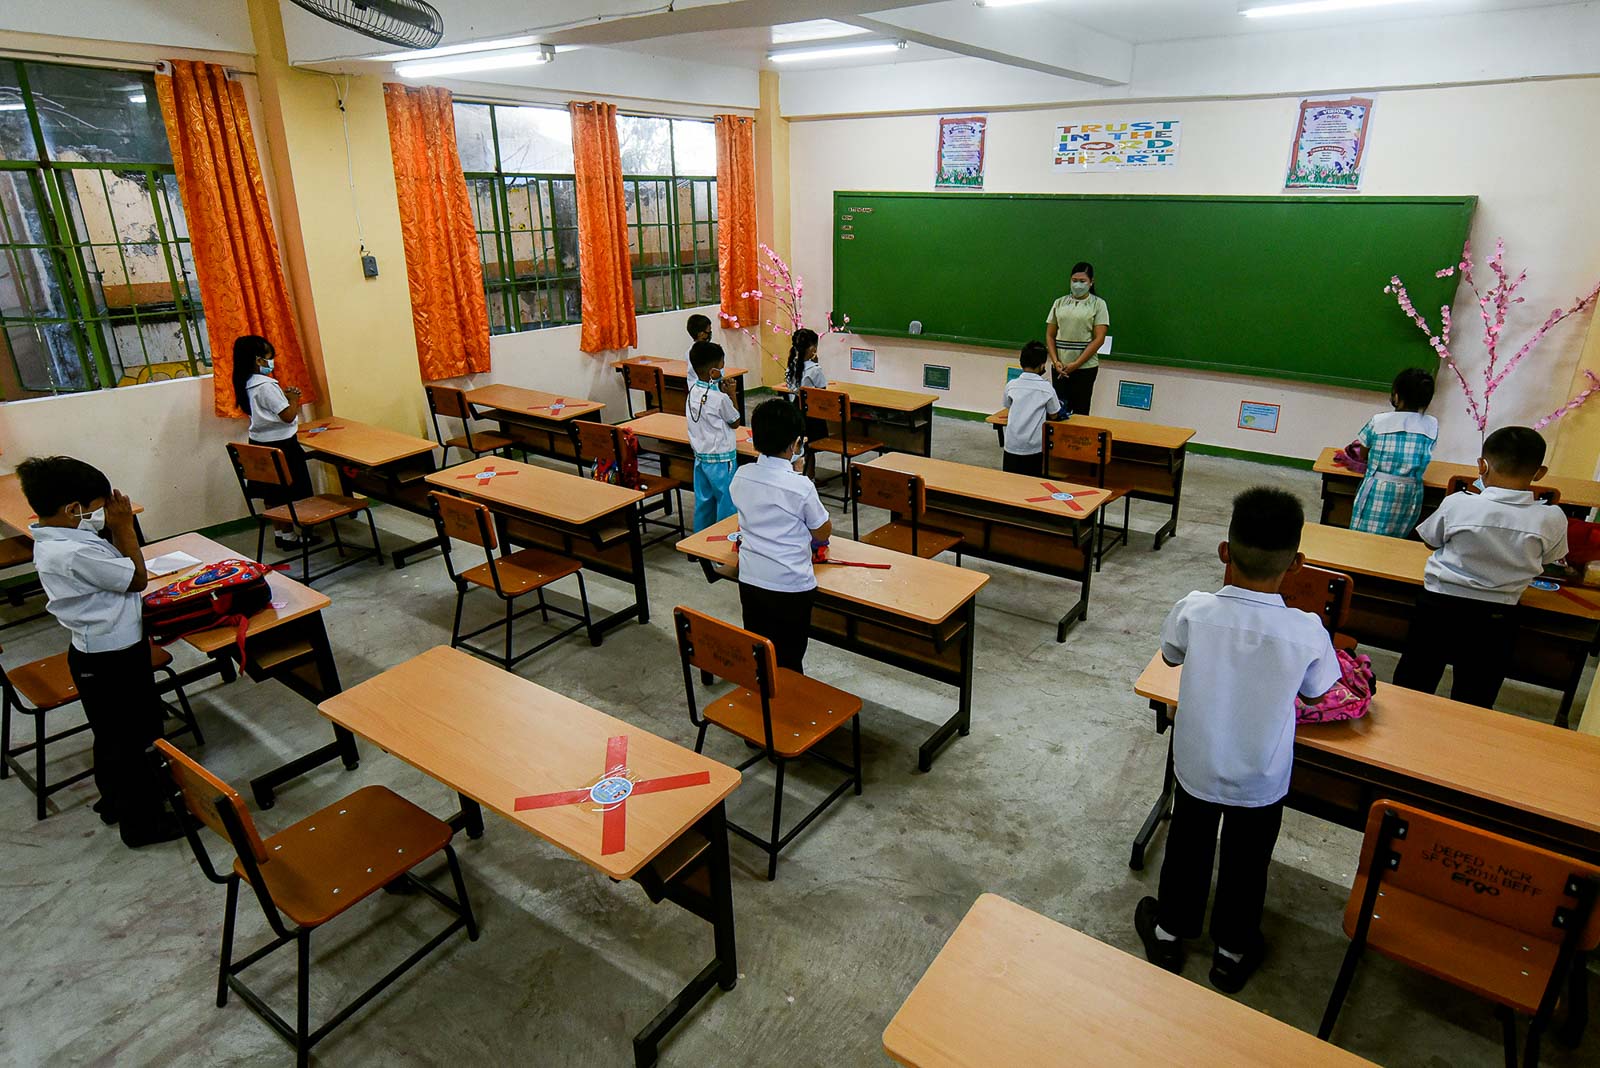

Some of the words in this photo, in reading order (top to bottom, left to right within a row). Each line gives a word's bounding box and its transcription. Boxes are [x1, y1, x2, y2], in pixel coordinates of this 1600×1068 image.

[1057, 121, 1180, 134] TRUST
[1060, 134, 1090, 142] IN
[1108, 130, 1173, 140] THE
[1058, 139, 1174, 152] LORD
[1054, 153, 1174, 165] HEART
[1432, 843, 1485, 867] DEPED
[1498, 865, 1533, 883] NCR
[1442, 857, 1460, 870] CY
[1451, 872, 1500, 896] Ergo
